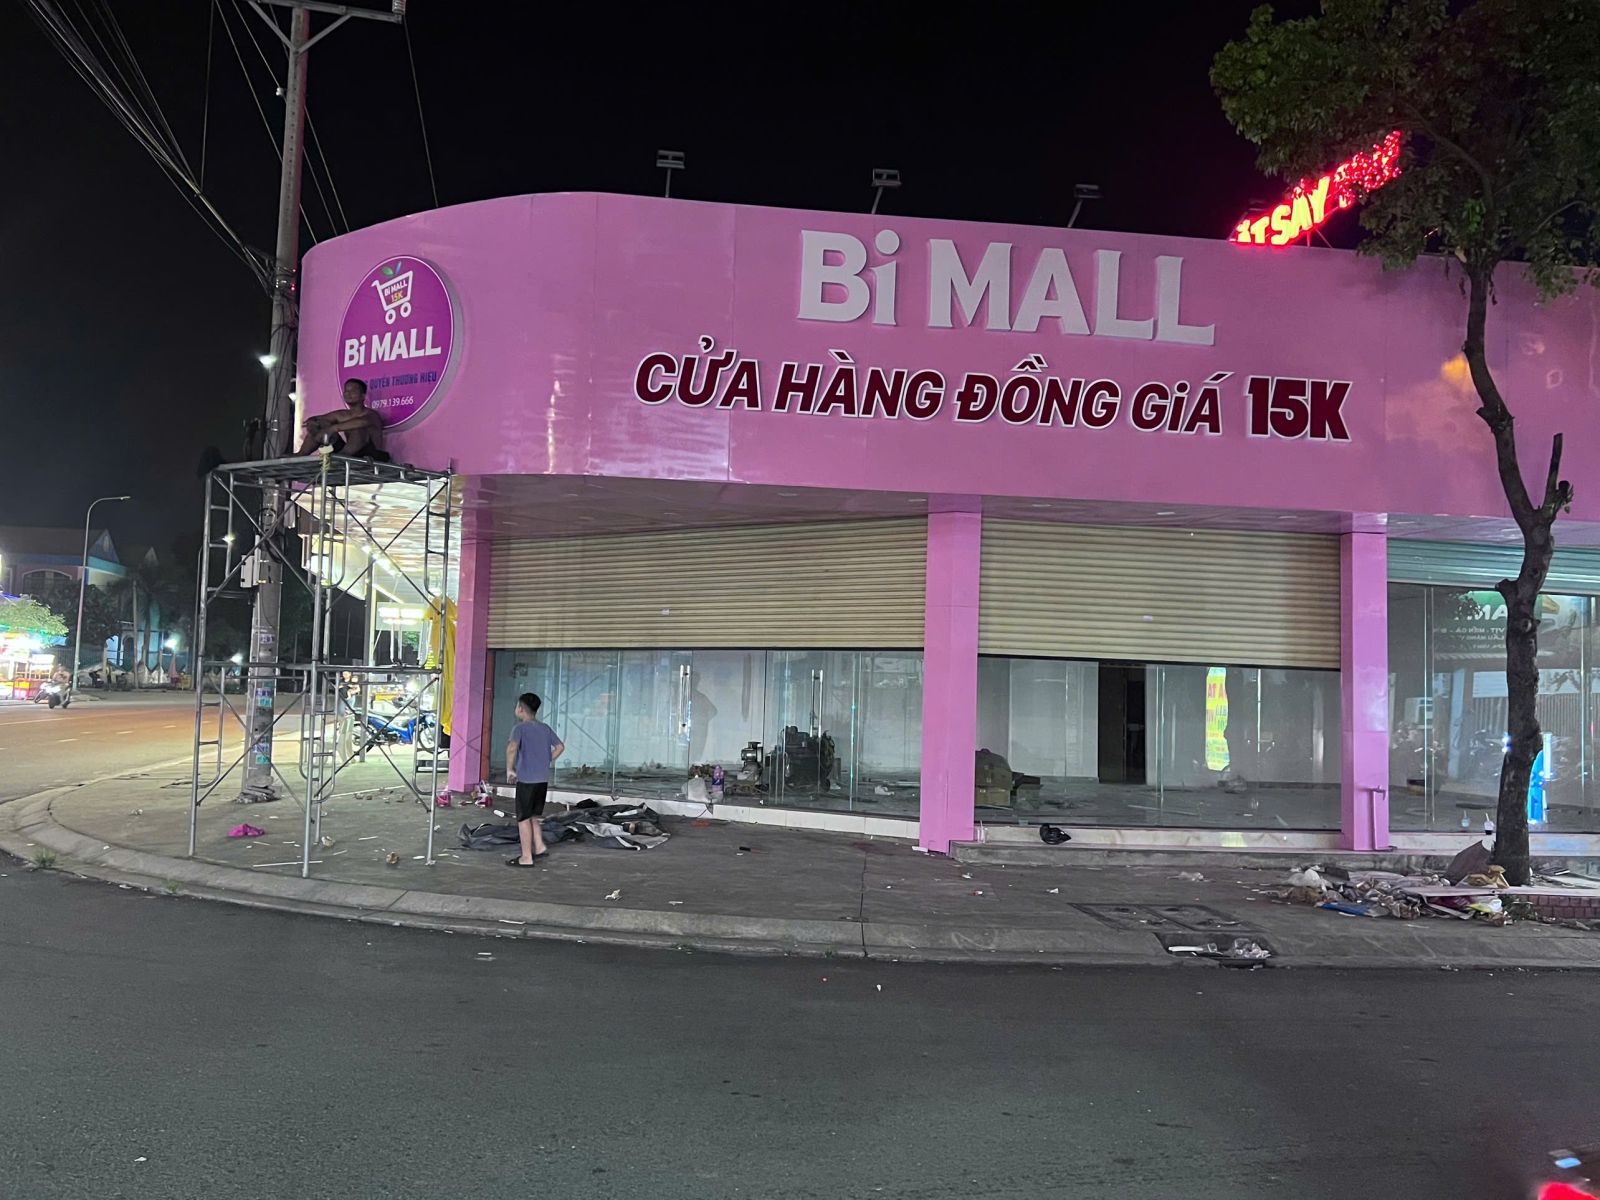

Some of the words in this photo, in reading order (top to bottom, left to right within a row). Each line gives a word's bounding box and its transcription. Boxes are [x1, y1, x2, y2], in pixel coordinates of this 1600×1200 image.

[797, 229, 900, 327] Bi
[927, 238, 1215, 346] MALL
[343, 335, 367, 368] Bi
[370, 326, 442, 364] MALL
[634, 335, 762, 411] CỬA
[771, 349, 946, 421] HÀNG
[953, 354, 1121, 430] ĐỒNG
[1247, 375, 1353, 442] 15K
